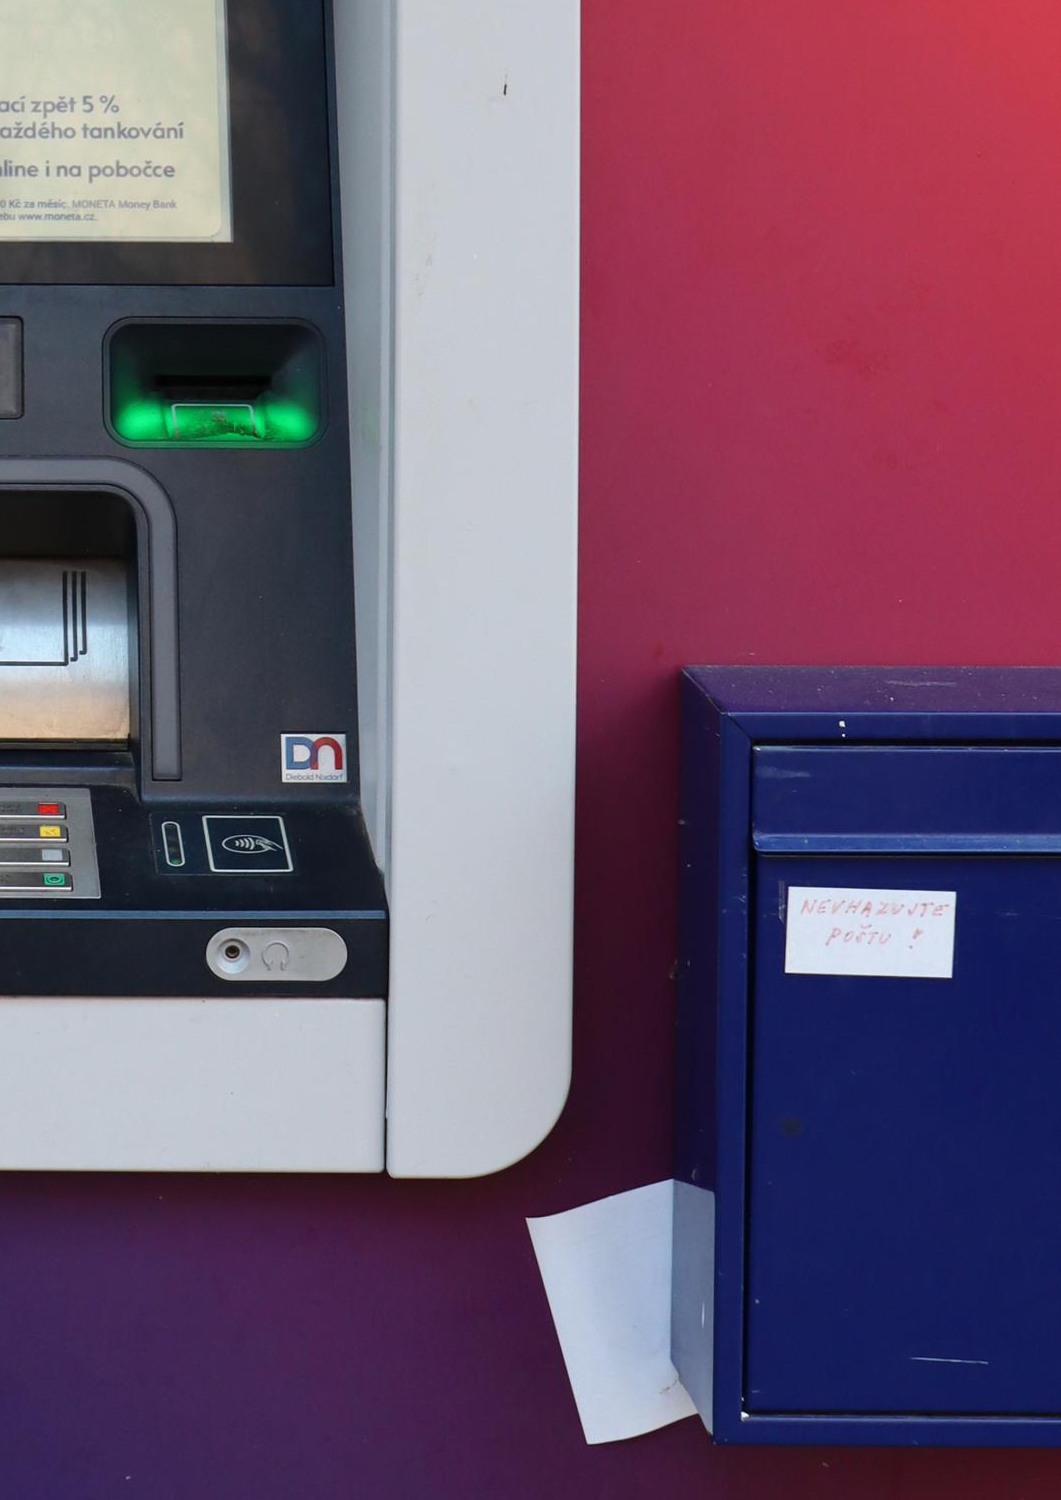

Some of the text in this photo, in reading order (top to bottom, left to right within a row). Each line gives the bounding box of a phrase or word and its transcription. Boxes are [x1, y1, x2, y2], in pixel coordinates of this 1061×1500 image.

[31, 95, 76, 118] zpět
[82, 96, 94, 113] 5
[100, 95, 119, 113] %
[82, 122, 184, 139] tankování
[45, 160, 51, 177] i
[56, 164, 81, 177] na
[89, 159, 176, 182] pobočce
[24, 201, 35, 209] za
[72, 200, 116, 209] MONETA
[118, 200, 151, 211] Money
[153, 200, 177, 210] Bank
[800, 899, 950, 918] NEVHAZUJTE
[825, 924, 892, 946] POŠTU
